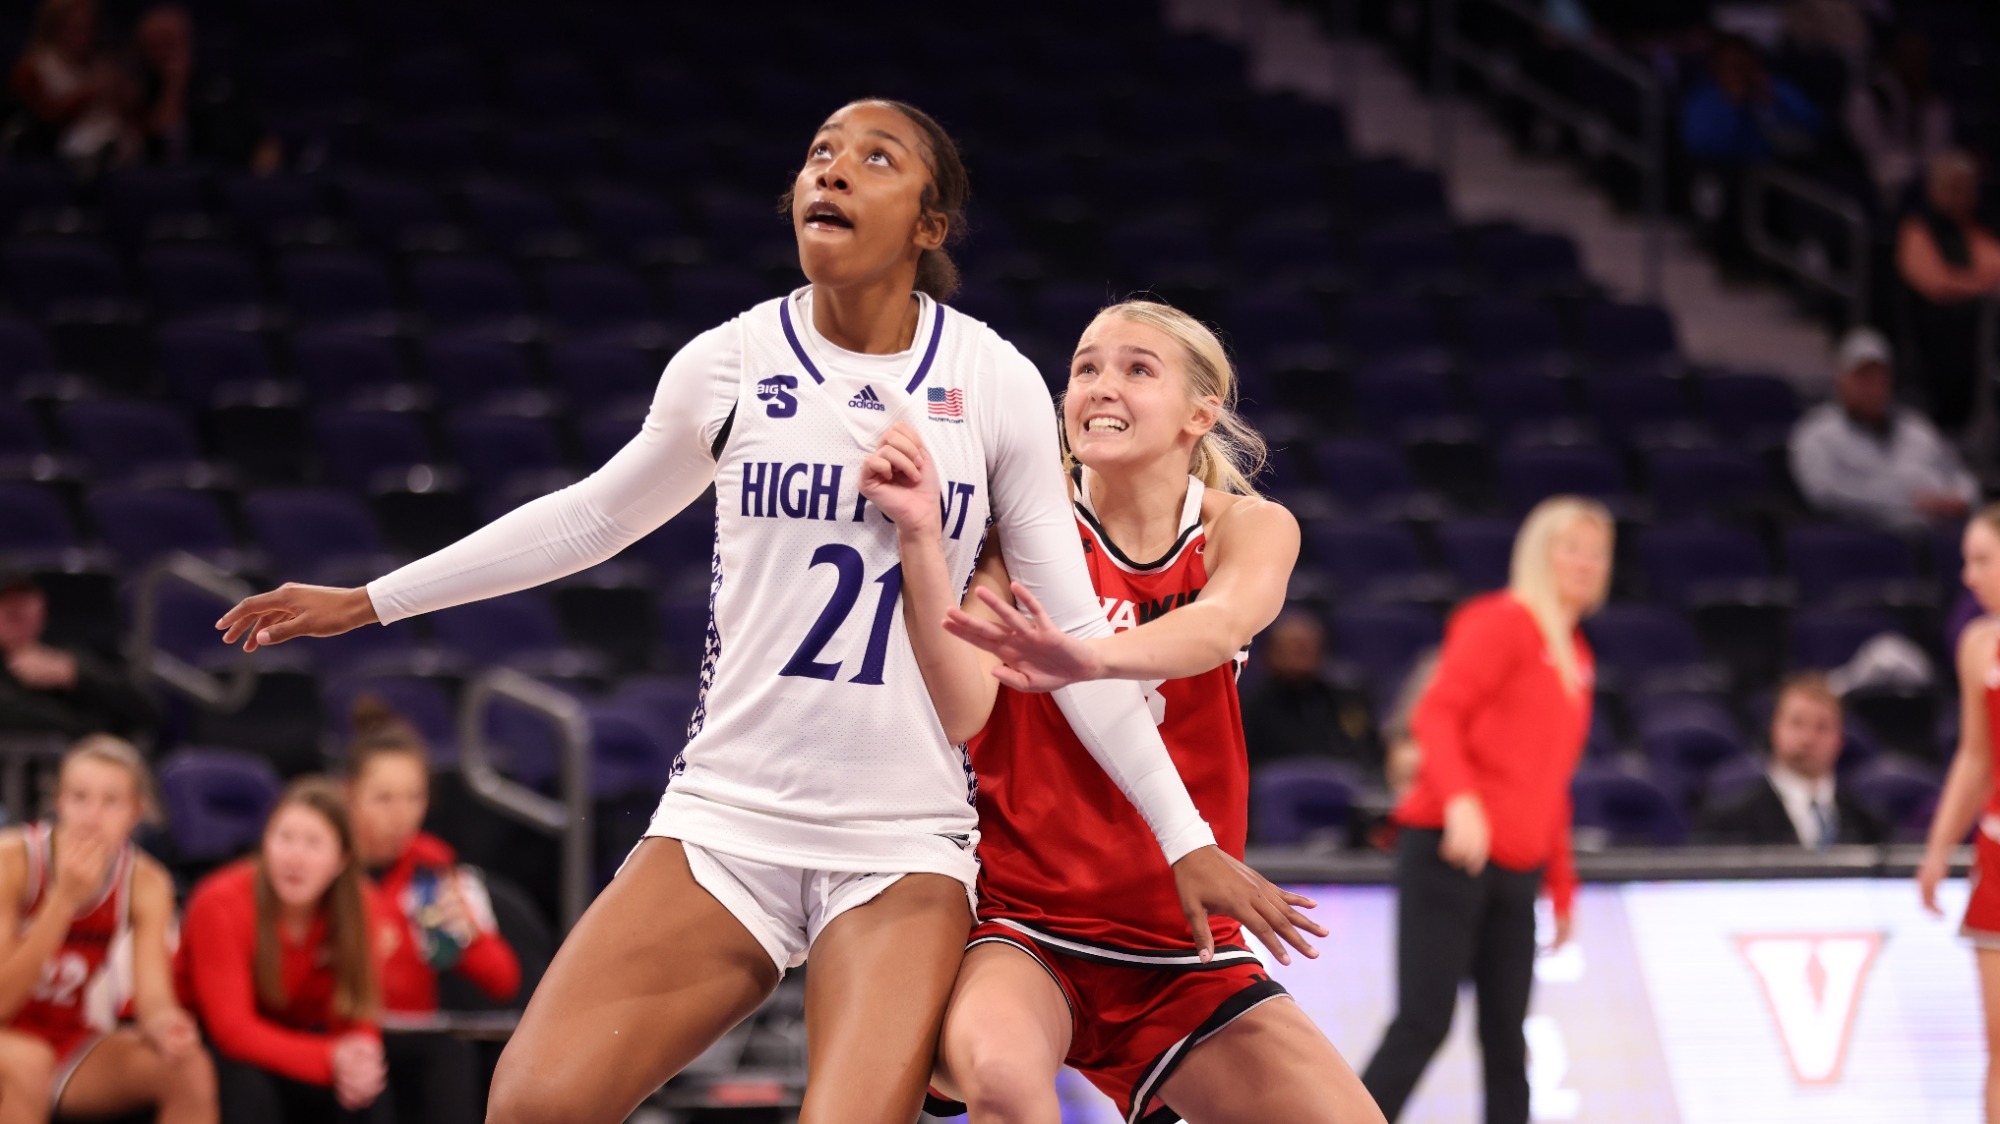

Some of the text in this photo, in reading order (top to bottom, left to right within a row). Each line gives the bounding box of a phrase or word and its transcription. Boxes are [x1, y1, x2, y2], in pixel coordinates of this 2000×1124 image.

[756, 384, 779, 395] BIG
[848, 399, 886, 412] adidas
[741, 462, 844, 521] HIGH
[778, 543, 903, 686] 21
[1732, 930, 1886, 1086] V
